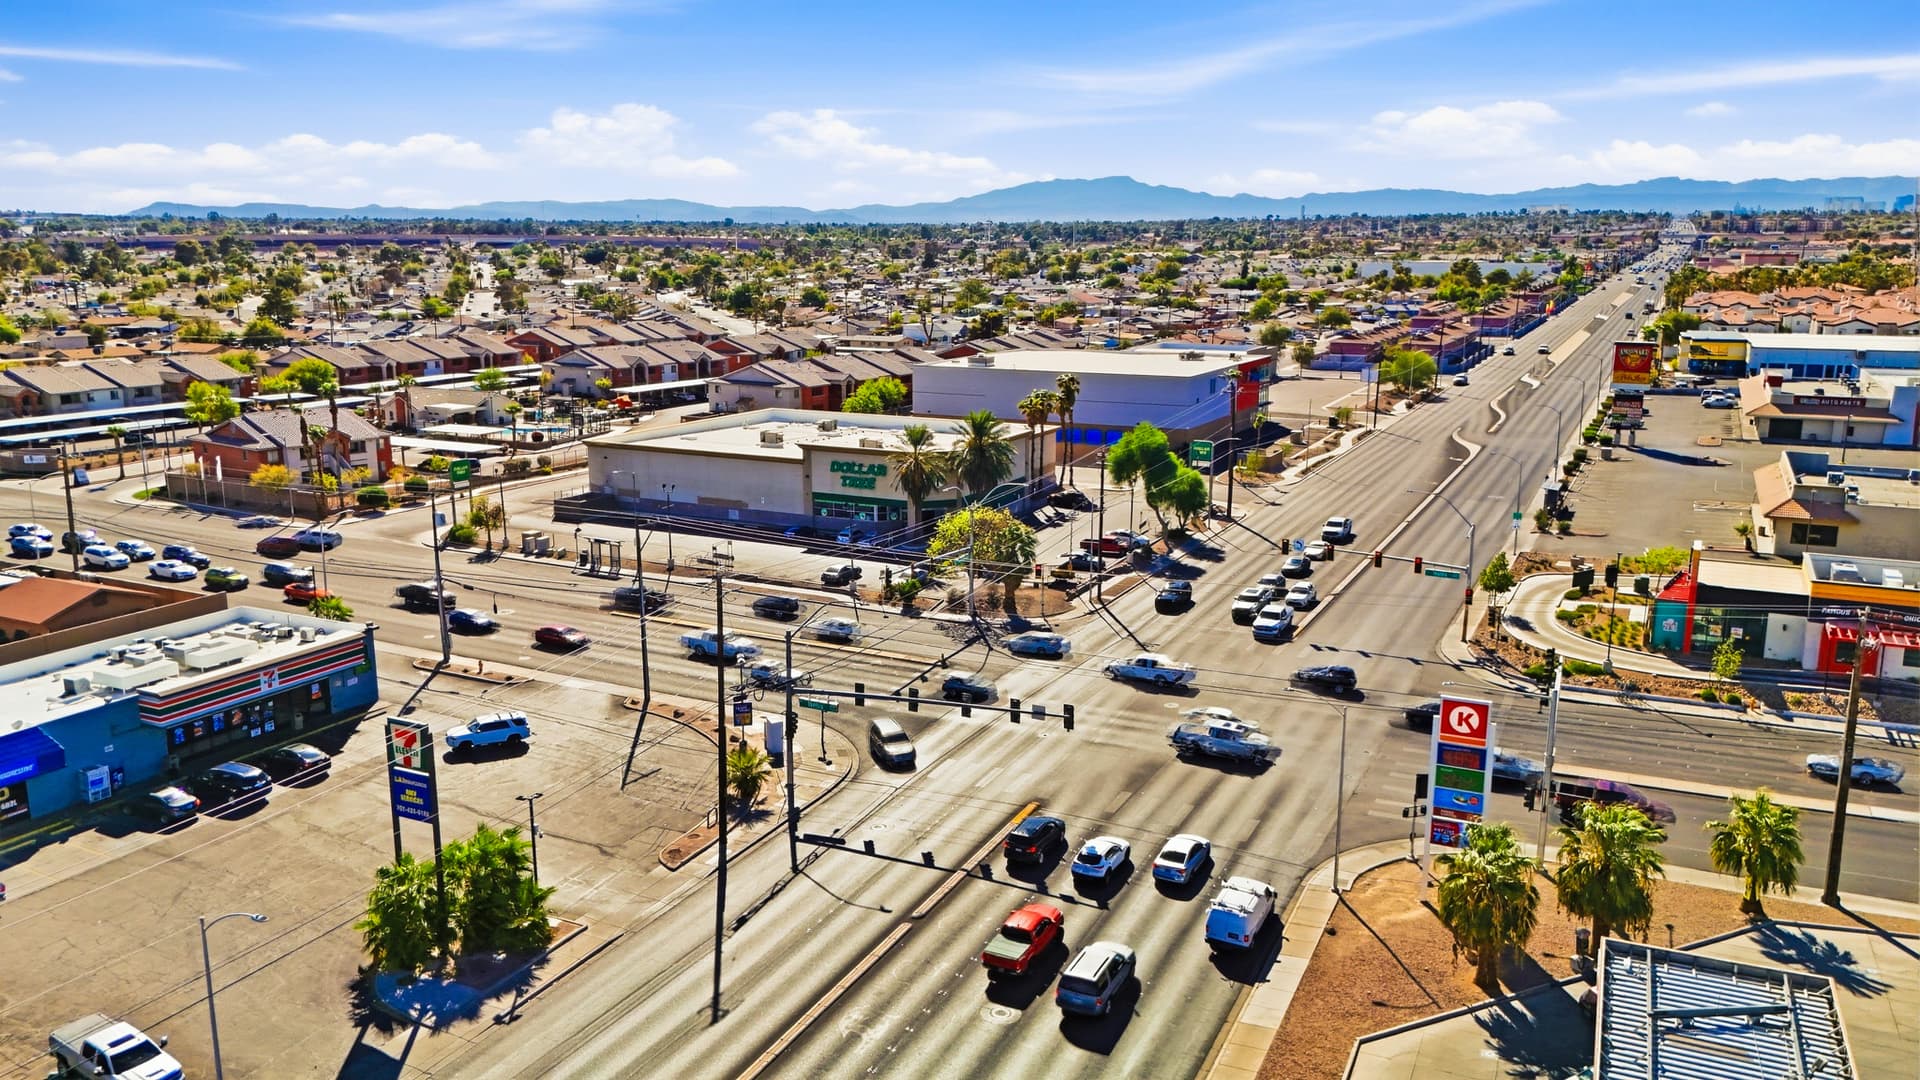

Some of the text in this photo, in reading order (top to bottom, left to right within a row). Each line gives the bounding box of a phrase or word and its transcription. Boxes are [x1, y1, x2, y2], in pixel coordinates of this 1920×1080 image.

[830, 460, 887, 477] DOLLAR
[841, 476, 876, 489] TREE
[1821, 607, 1851, 616] FAMOUS
[1457, 711, 1476, 731] K
